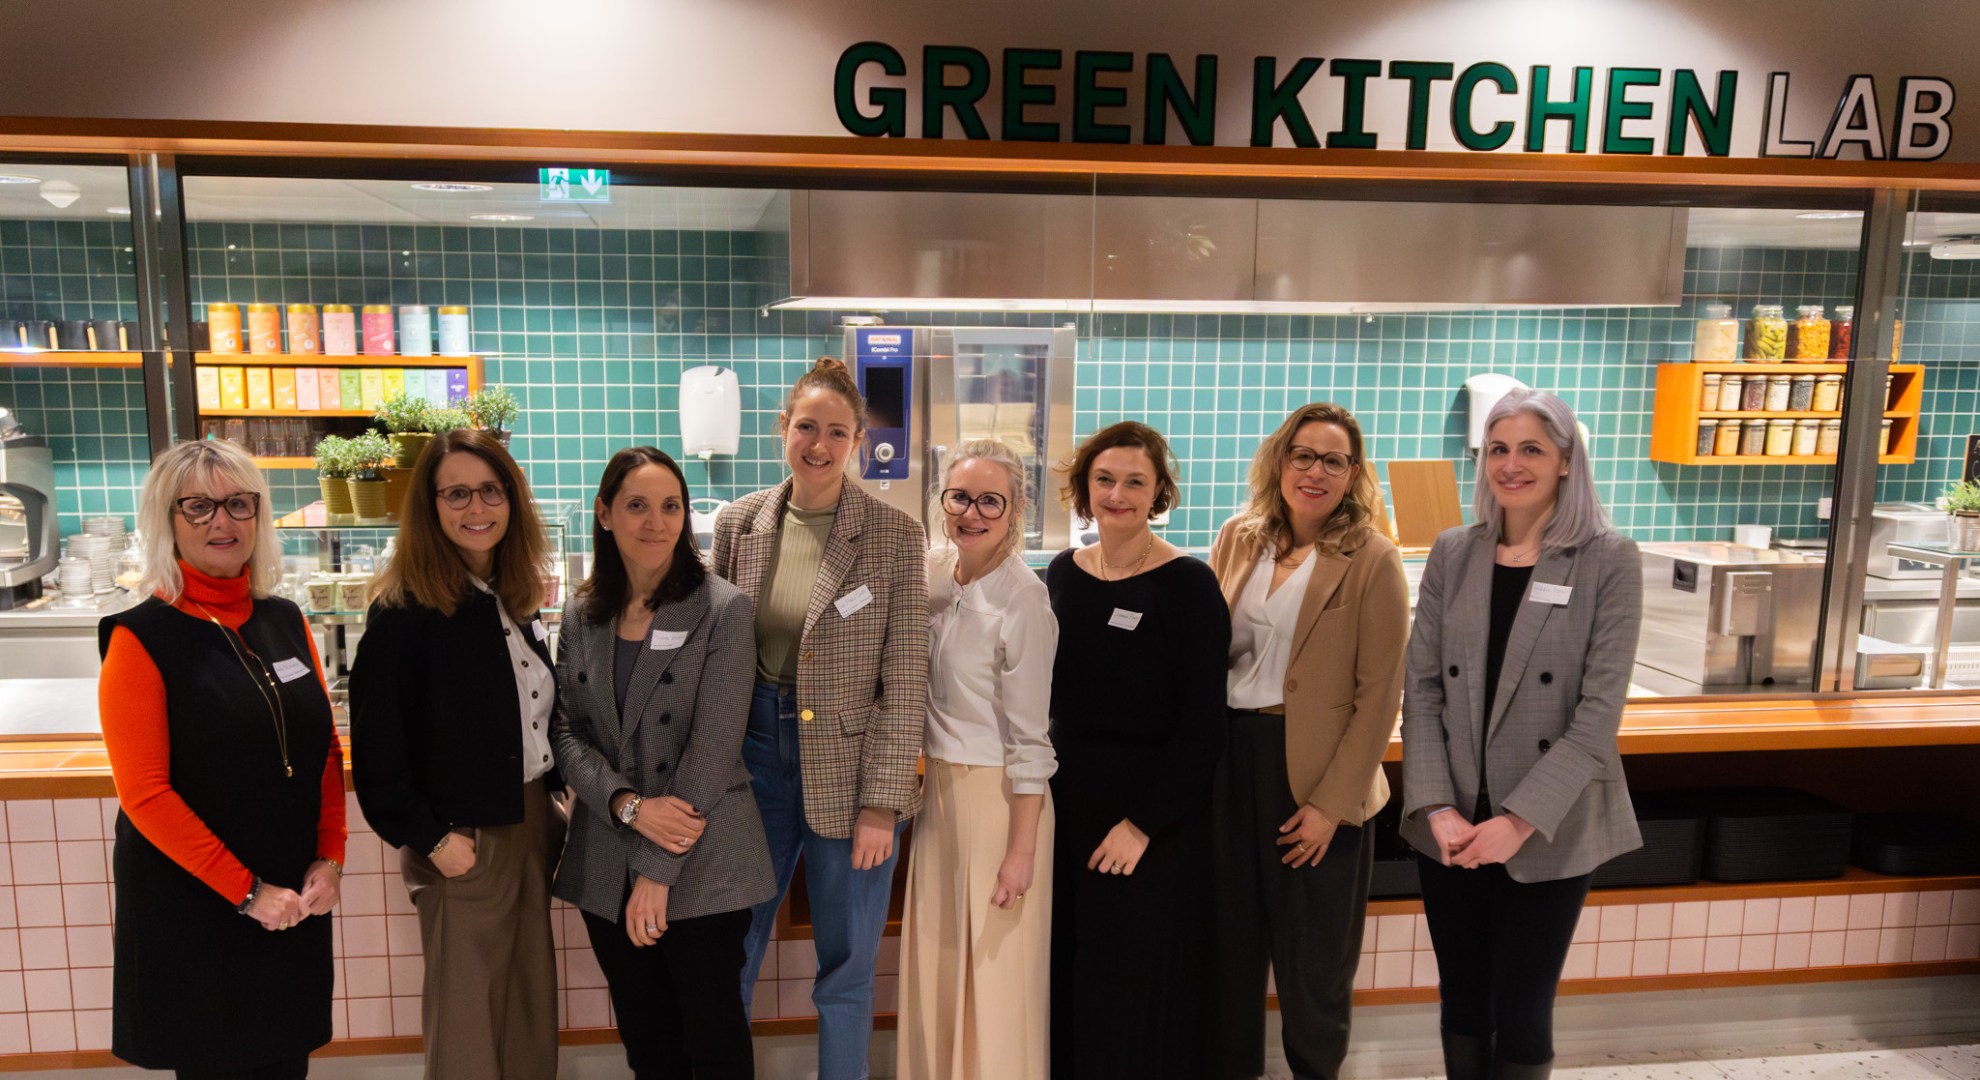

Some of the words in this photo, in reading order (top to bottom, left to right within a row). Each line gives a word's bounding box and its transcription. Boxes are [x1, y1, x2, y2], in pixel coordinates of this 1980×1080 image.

[834, 41, 1218, 146] GREEN
[1251, 56, 1738, 157] KITCHEN
[1758, 71, 1956, 161] LAB
